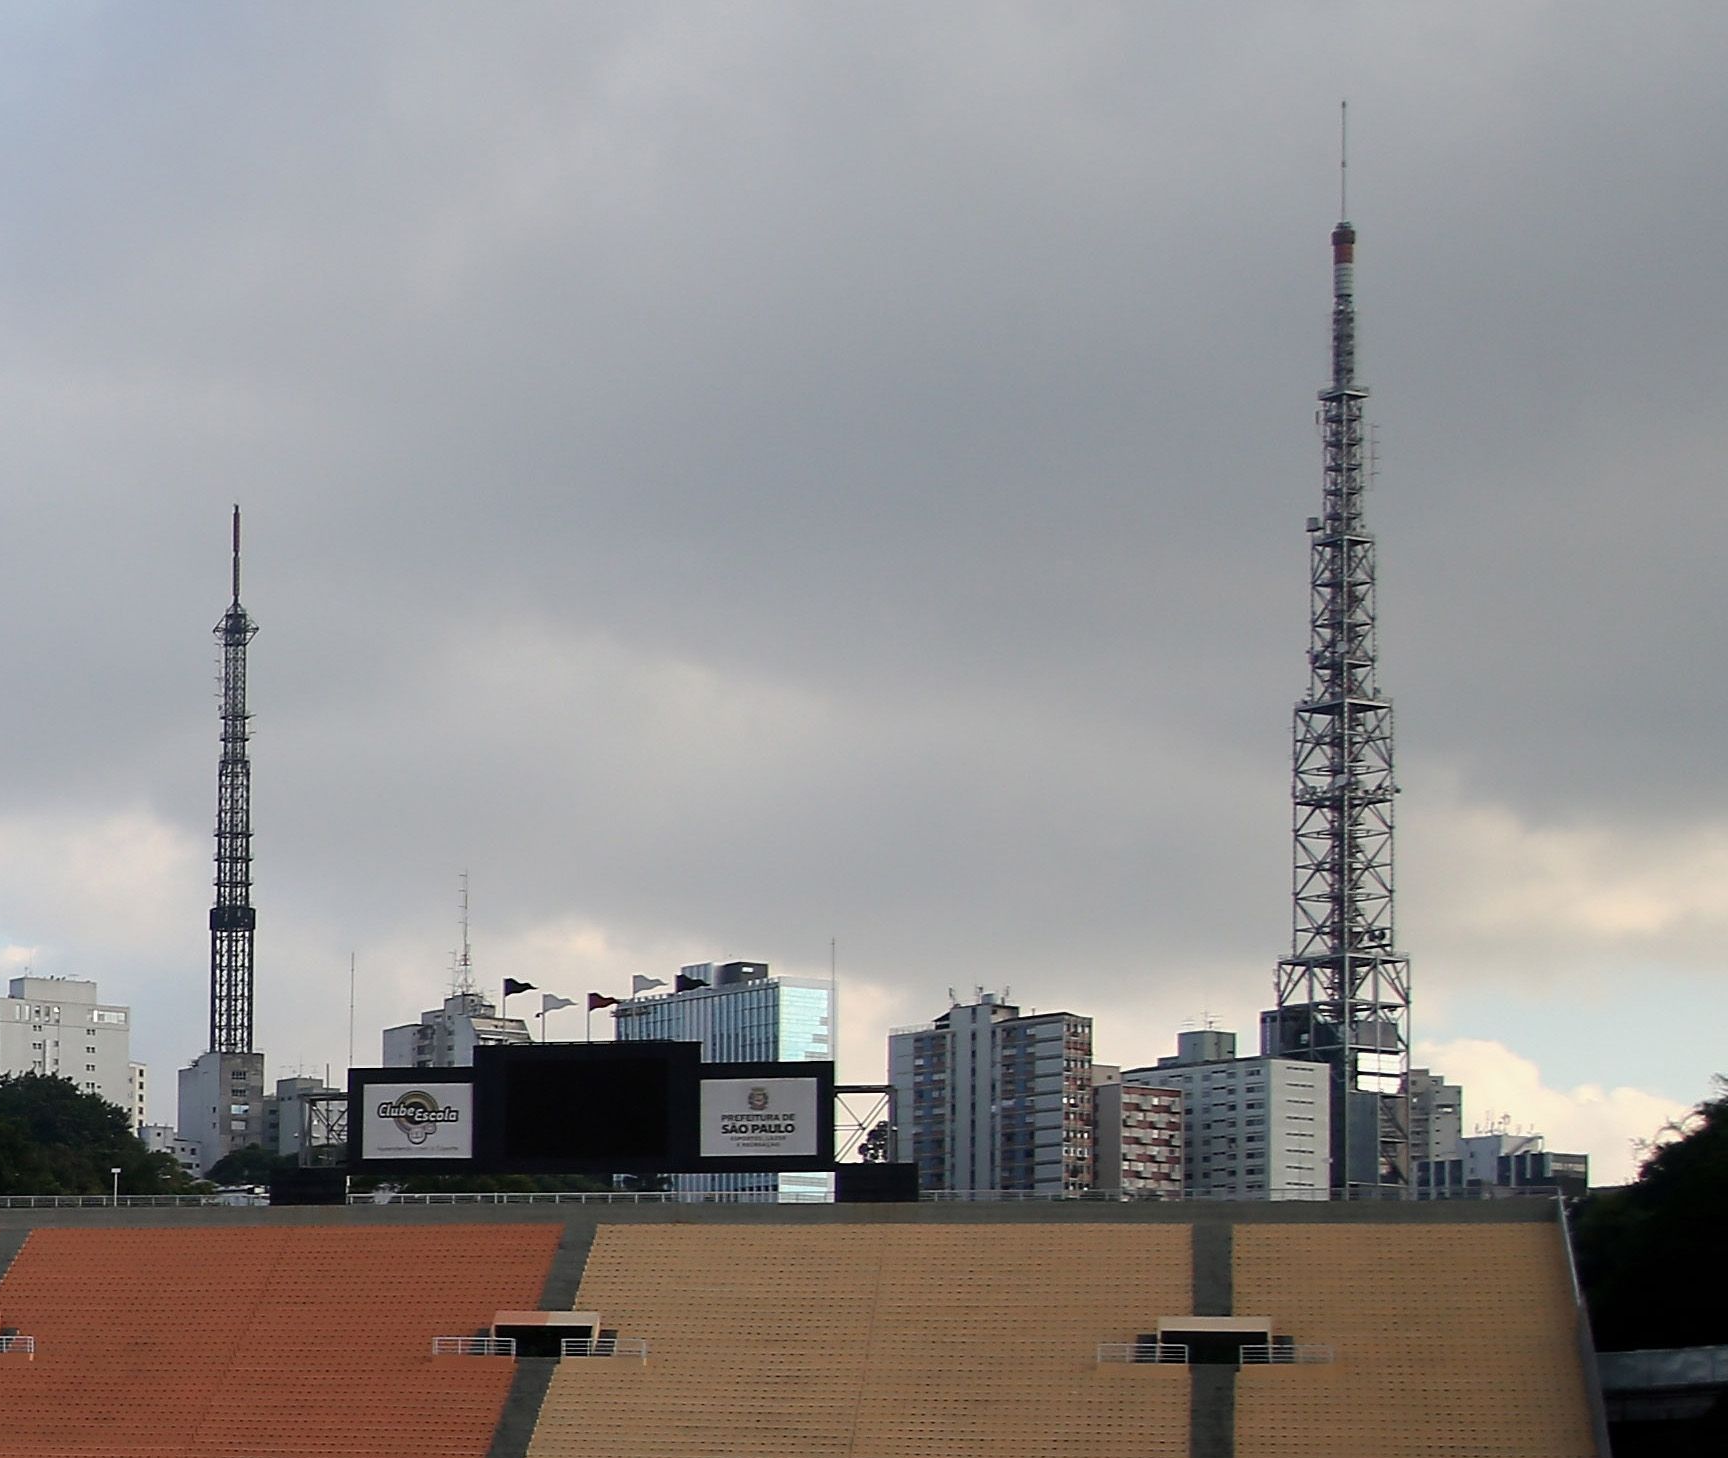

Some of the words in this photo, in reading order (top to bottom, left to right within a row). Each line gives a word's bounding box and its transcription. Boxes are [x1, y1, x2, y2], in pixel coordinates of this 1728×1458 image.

[378, 1103, 415, 1117] Clube
[414, 1107, 458, 1121] Escola
[721, 1122, 748, 1134] SÃO
[751, 1124, 795, 1134] PAULO
